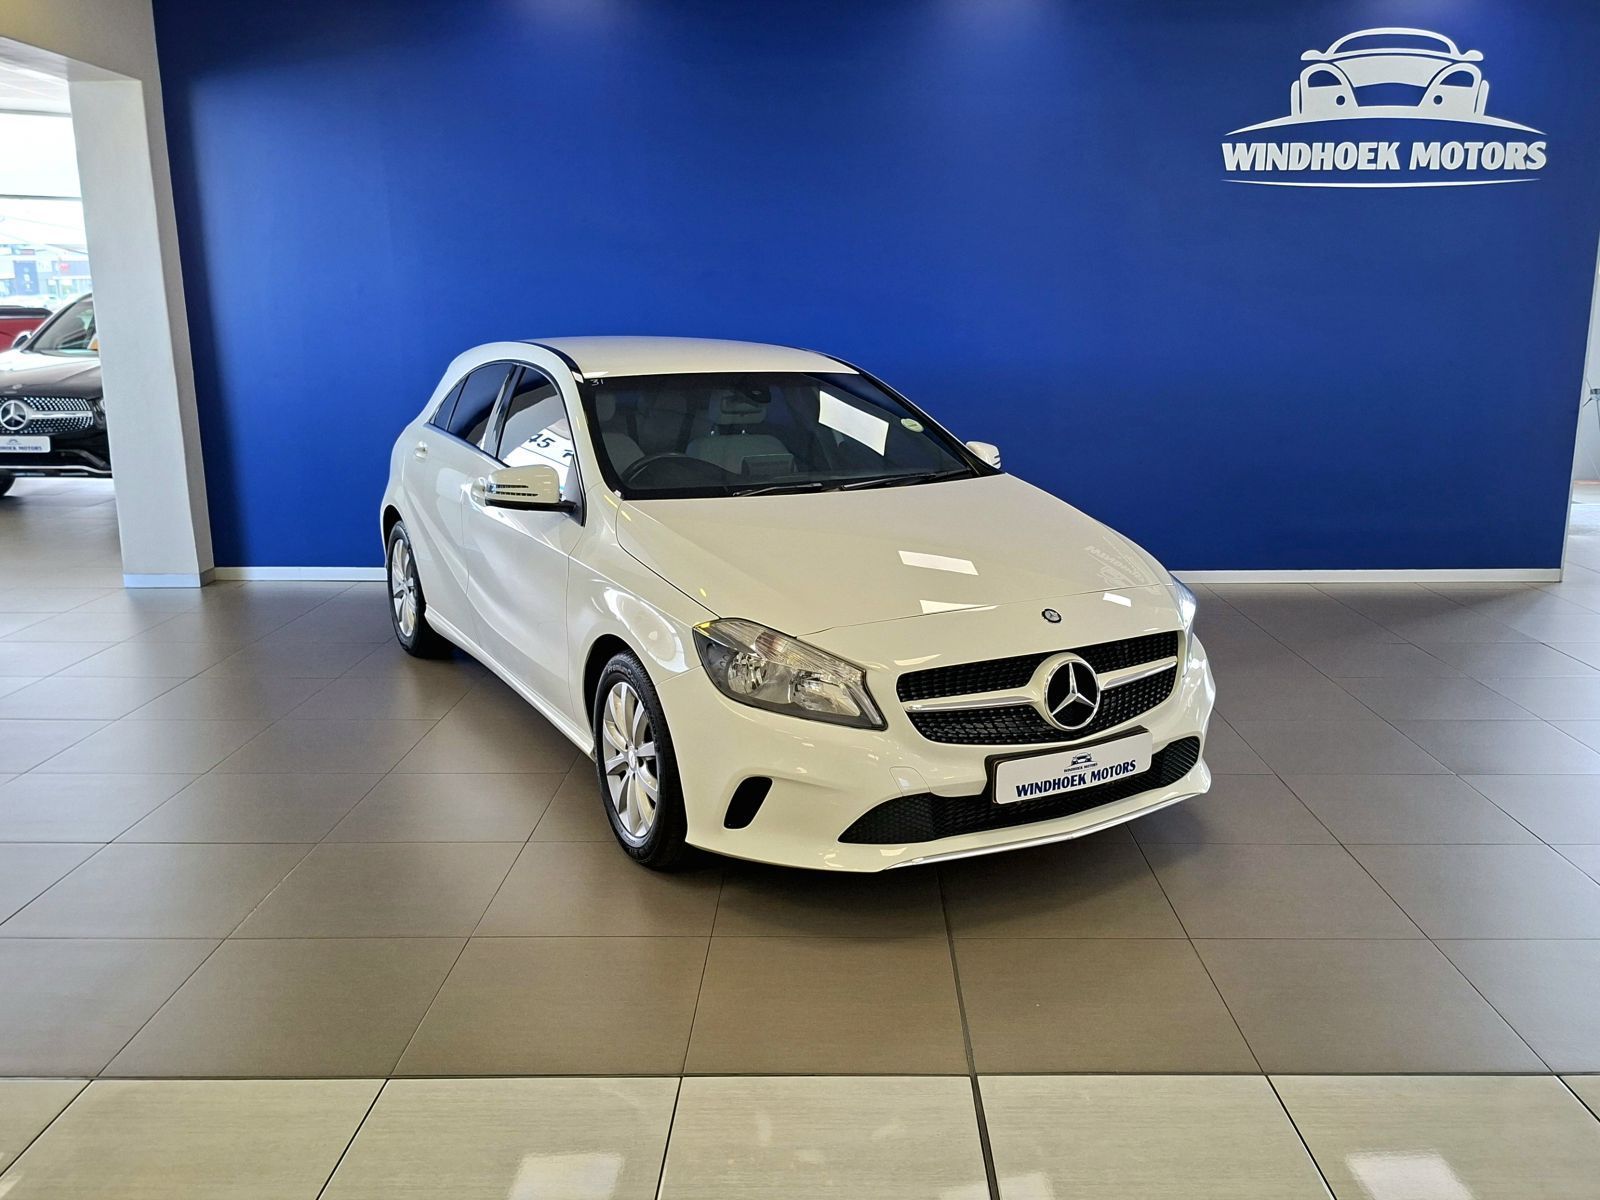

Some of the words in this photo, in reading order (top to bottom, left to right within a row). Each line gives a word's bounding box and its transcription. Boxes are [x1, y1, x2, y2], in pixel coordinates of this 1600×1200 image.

[1221, 141, 1400, 171] WINDHOEK
[1408, 141, 1547, 171] MOTORS
[1016, 773, 1087, 797] WINDHOEK
[1090, 760, 1136, 783] MOTORS
